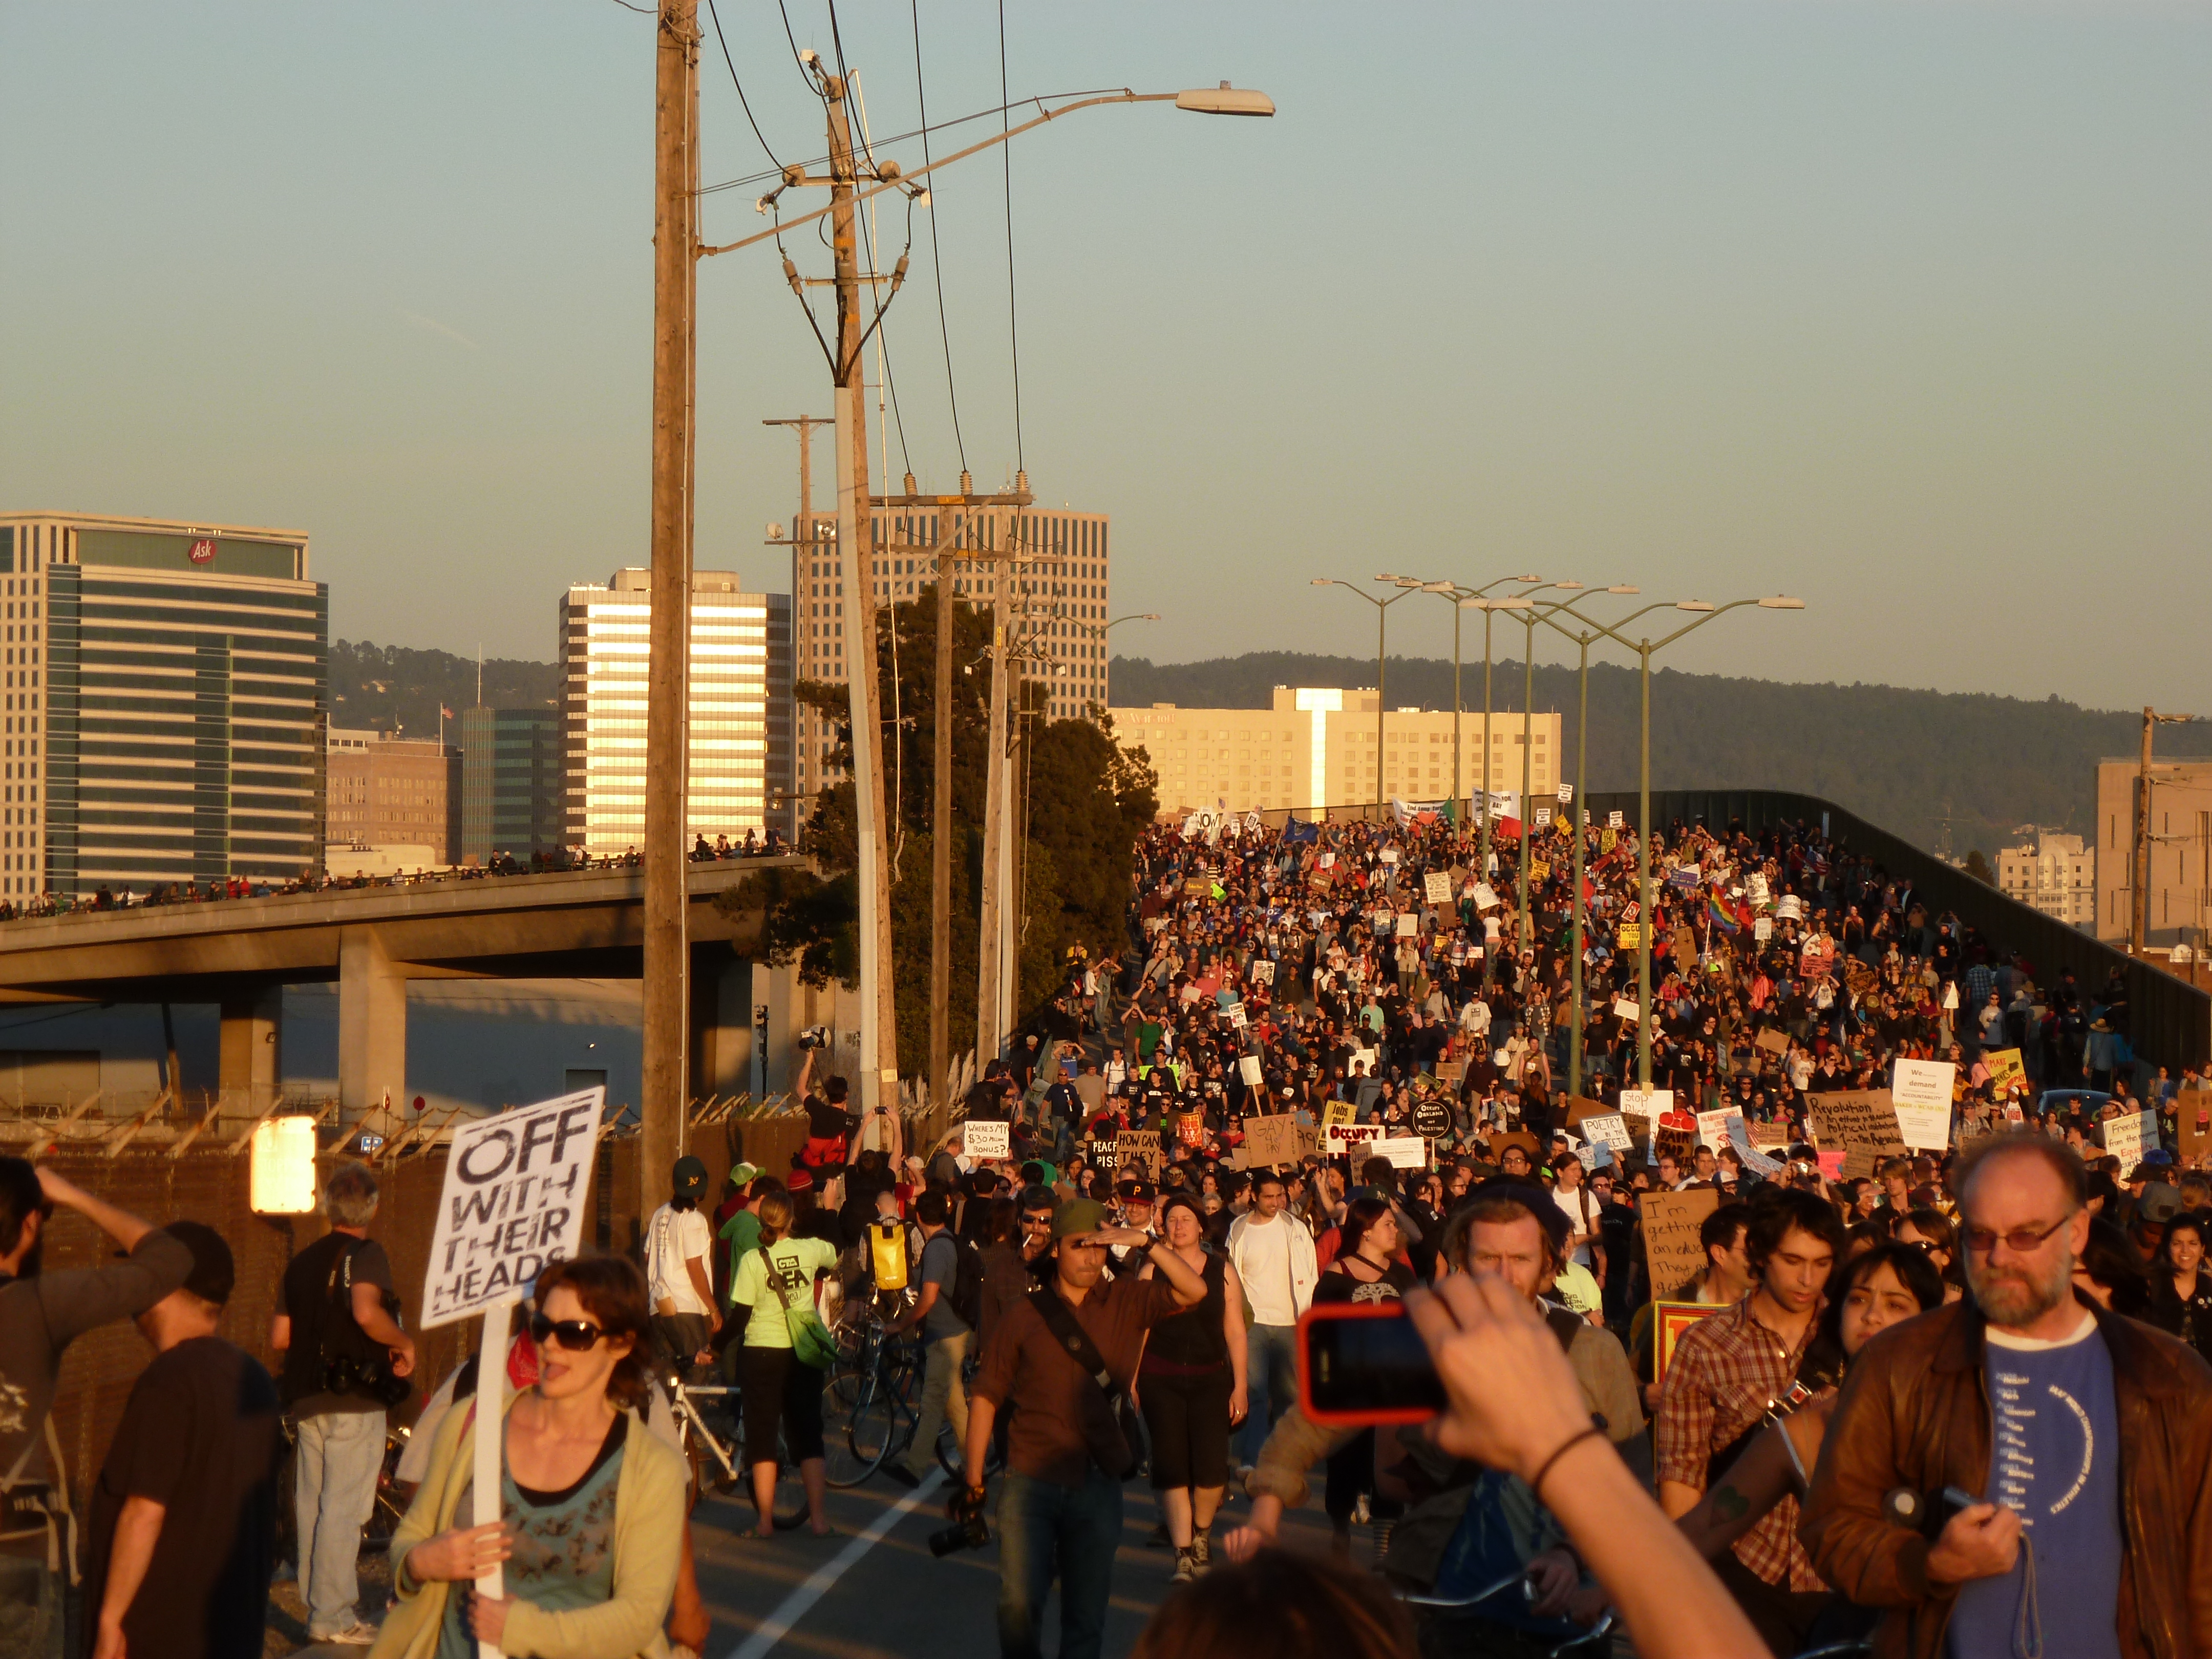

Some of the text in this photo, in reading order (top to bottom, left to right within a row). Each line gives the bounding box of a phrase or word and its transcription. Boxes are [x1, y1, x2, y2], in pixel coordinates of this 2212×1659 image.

[193, 540, 211, 559] Ask
[1989, 1057, 2006, 1068] MAKE
[1909, 1080, 1937, 1089] demand
[1995, 1070, 2011, 1085] ANKS
[1625, 1092, 1649, 1107] Stop
[1809, 1097, 1871, 1115] Revolution
[1332, 1103, 1349, 1117] Jobs
[995, 1124, 1008, 1135] MY
[1253, 1116, 1286, 1137] GAY
[1585, 1117, 1620, 1131] POETRY
[1826, 1123, 1867, 1134] Political
[2112, 1119, 2148, 1134] Freedom
[968, 1134, 987, 1144] $30
[1265, 1134, 1273, 1144] 4
[1330, 1125, 1380, 1141] OCCUPY
[456, 1102, 592, 1185] OFF
[1118, 1134, 1160, 1147] HOW CAN
[2109, 1138, 2123, 1148] from
[2126, 1134, 2138, 1143] this
[973, 1144, 1006, 1156] BONUS?
[1266, 1142, 1280, 1156] PAY
[2120, 1142, 2154, 1160] Equality
[1352, 1150, 1369, 1164] Queer
[2120, 1155, 2143, 1168] curity
[451, 1162, 580, 1232] WITH
[1133, 1185, 1141, 1196] P
[1646, 1197, 1687, 1220] I'm
[443, 1206, 570, 1273] THEIR
[1653, 1245, 1671, 1254] an
[778, 1258, 798, 1268] CTA
[1652, 1261, 1709, 1277] They ar
[432, 1246, 567, 1311] HEADS
